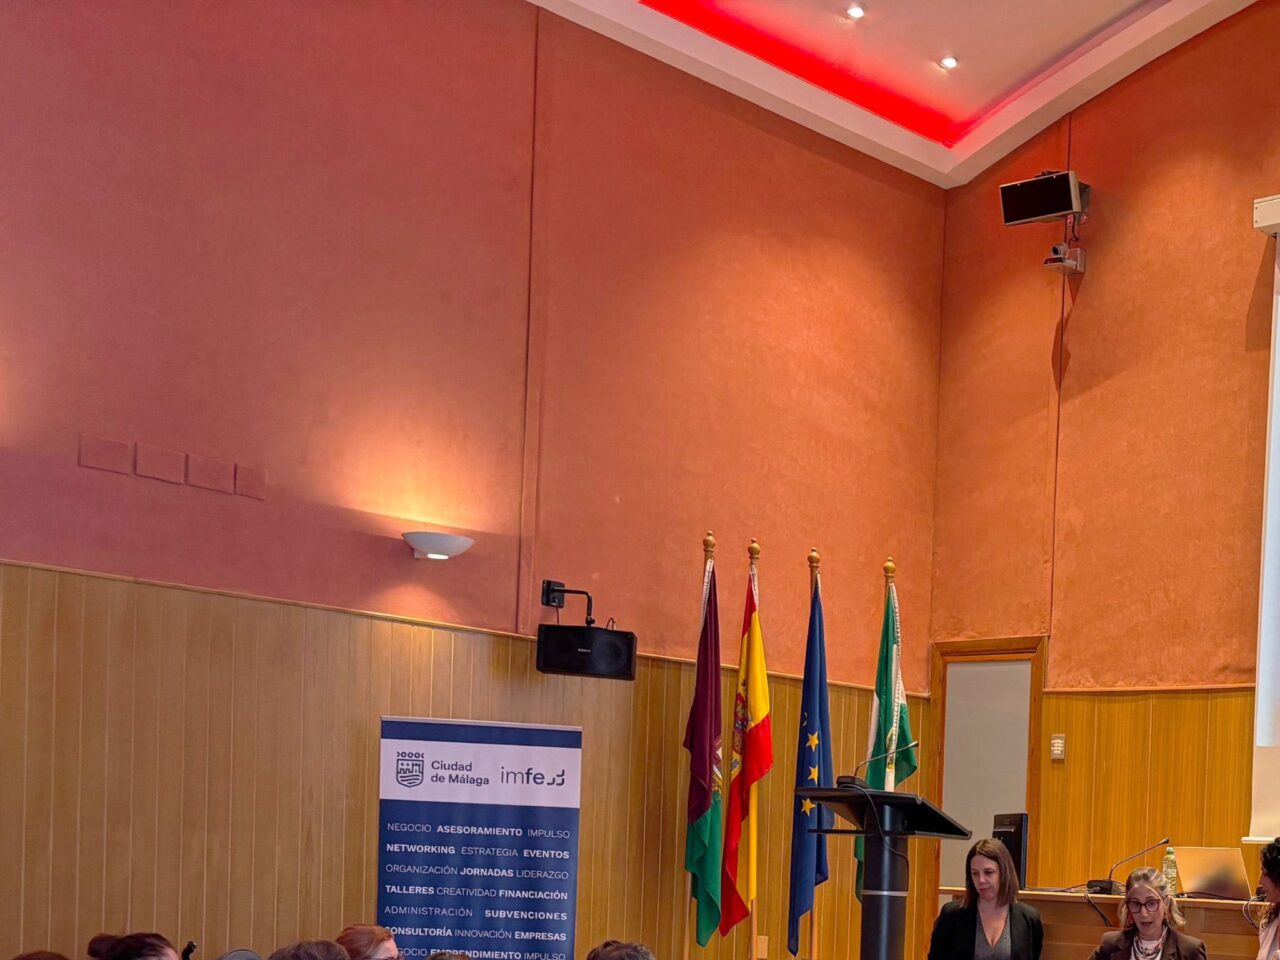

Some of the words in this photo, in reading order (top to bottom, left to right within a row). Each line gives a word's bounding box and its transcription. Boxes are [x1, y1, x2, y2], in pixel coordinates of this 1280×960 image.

[431, 760, 472, 772] Ciudad
[431, 774, 446, 783] de
[448, 774, 489, 786] Málaga
[501, 767, 545, 785] imfe
[387, 822, 431, 832] NEGOCIO
[437, 825, 522, 837] ASESORAMIENTO
[528, 829, 570, 839] IMPULSO
[387, 844, 455, 854] NETWORKING
[461, 847, 518, 857] ESTRATEGIA
[523, 849, 569, 859] EVENTOS
[385, 864, 457, 875] ORGANIZACIÓN
[460, 868, 514, 877] JORNADAS
[516, 869, 568, 880] LIDERAZGO
[385, 885, 434, 895] TALLERES
[437, 887, 497, 897] CREATIVIDAD
[499, 888, 568, 900] FINANCIACIÓN
[384, 906, 473, 917] ADMINISTRACIÓN
[485, 909, 567, 920] SUBVENCIONES
[455, 928, 512, 939] INNOVACIÓN
[515, 931, 567, 941] EMPRESAS
